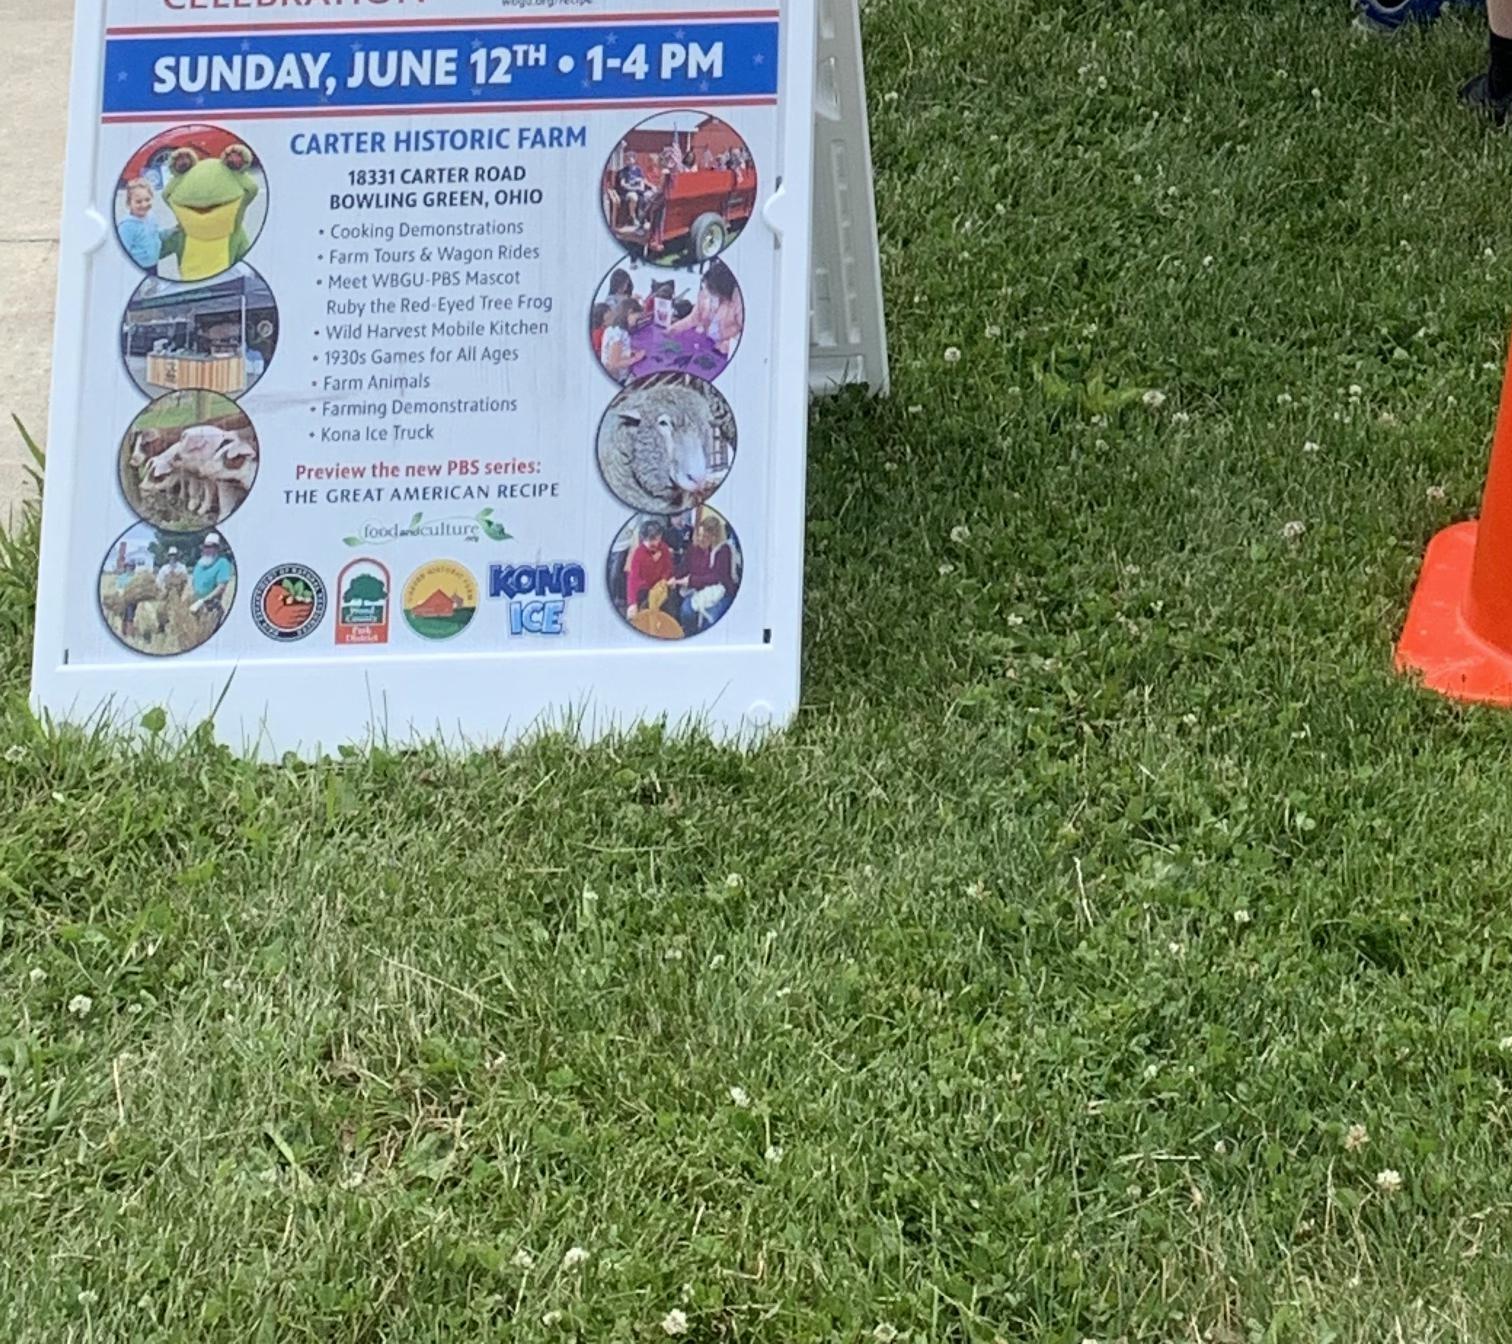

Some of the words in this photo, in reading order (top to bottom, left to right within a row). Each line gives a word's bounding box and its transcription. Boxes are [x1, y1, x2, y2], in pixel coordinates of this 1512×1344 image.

[153, 51, 336, 96] SUNDAY,
[347, 48, 458, 89] JUNE
[586, 45, 649, 81] 1-4
[660, 42, 724, 81] PM
[289, 132, 386, 155] CARTER
[393, 128, 510, 152] HISTORIC
[517, 125, 587, 149] FARM
[347, 168, 396, 186] 18331
[400, 167, 469, 184] CARTER
[475, 165, 527, 182] ROAD
[329, 192, 418, 210] BOWLING
[422, 190, 490, 209] GREEN,
[494, 188, 544, 206] OHIO
[330, 222, 395, 241] Cooking
[399, 219, 524, 238] Demonstrations
[329, 249, 371, 265] Farm
[374, 247, 416, 264] Tours
[419, 247, 433, 263] &
[437, 246, 494, 265] Wagon
[498, 244, 540, 260] Rides
[328, 274, 368, 290] Meet
[373, 271, 461, 288] WBGU-PBS
[465, 270, 521, 286] Mascot
[326, 299, 366, 317] Ruby
[370, 297, 396, 313] the
[400, 295, 475, 315] Red-Eyed
[479, 295, 513, 311] Tree
[517, 294, 553, 313] Frog
[325, 324, 363, 340] Wild
[366, 323, 427, 339] Harvest
[431, 321, 485, 337] Mobile
[489, 320, 549, 335] Kitchen
[324, 349, 367, 365] 1930s
[370, 348, 425, 364] Games
[429, 347, 452, 363] for
[456, 346, 477, 362] All
[481, 346, 519, 364] Ages
[323, 375, 364, 391] Farm
[367, 373, 431, 389] Animals
[322, 400, 387, 420] Farming
[391, 397, 518, 414] Demonstrations
[320, 426, 361, 442] Kona
[365, 425, 389, 441] Ice
[393, 424, 435, 440] Truck
[295, 463, 366, 480] Preview
[371, 461, 401, 477] the
[404, 464, 443, 477] new
[447, 460, 481, 476] PBS
[484, 458, 541, 475] series:
[283, 489, 318, 504] THE
[325, 487, 385, 503] GREAT
[389, 484, 490, 502] AMERICAN
[496, 482, 560, 498] RECIPE
[489, 563, 586, 599] KONA
[510, 600, 566, 635] ICE
